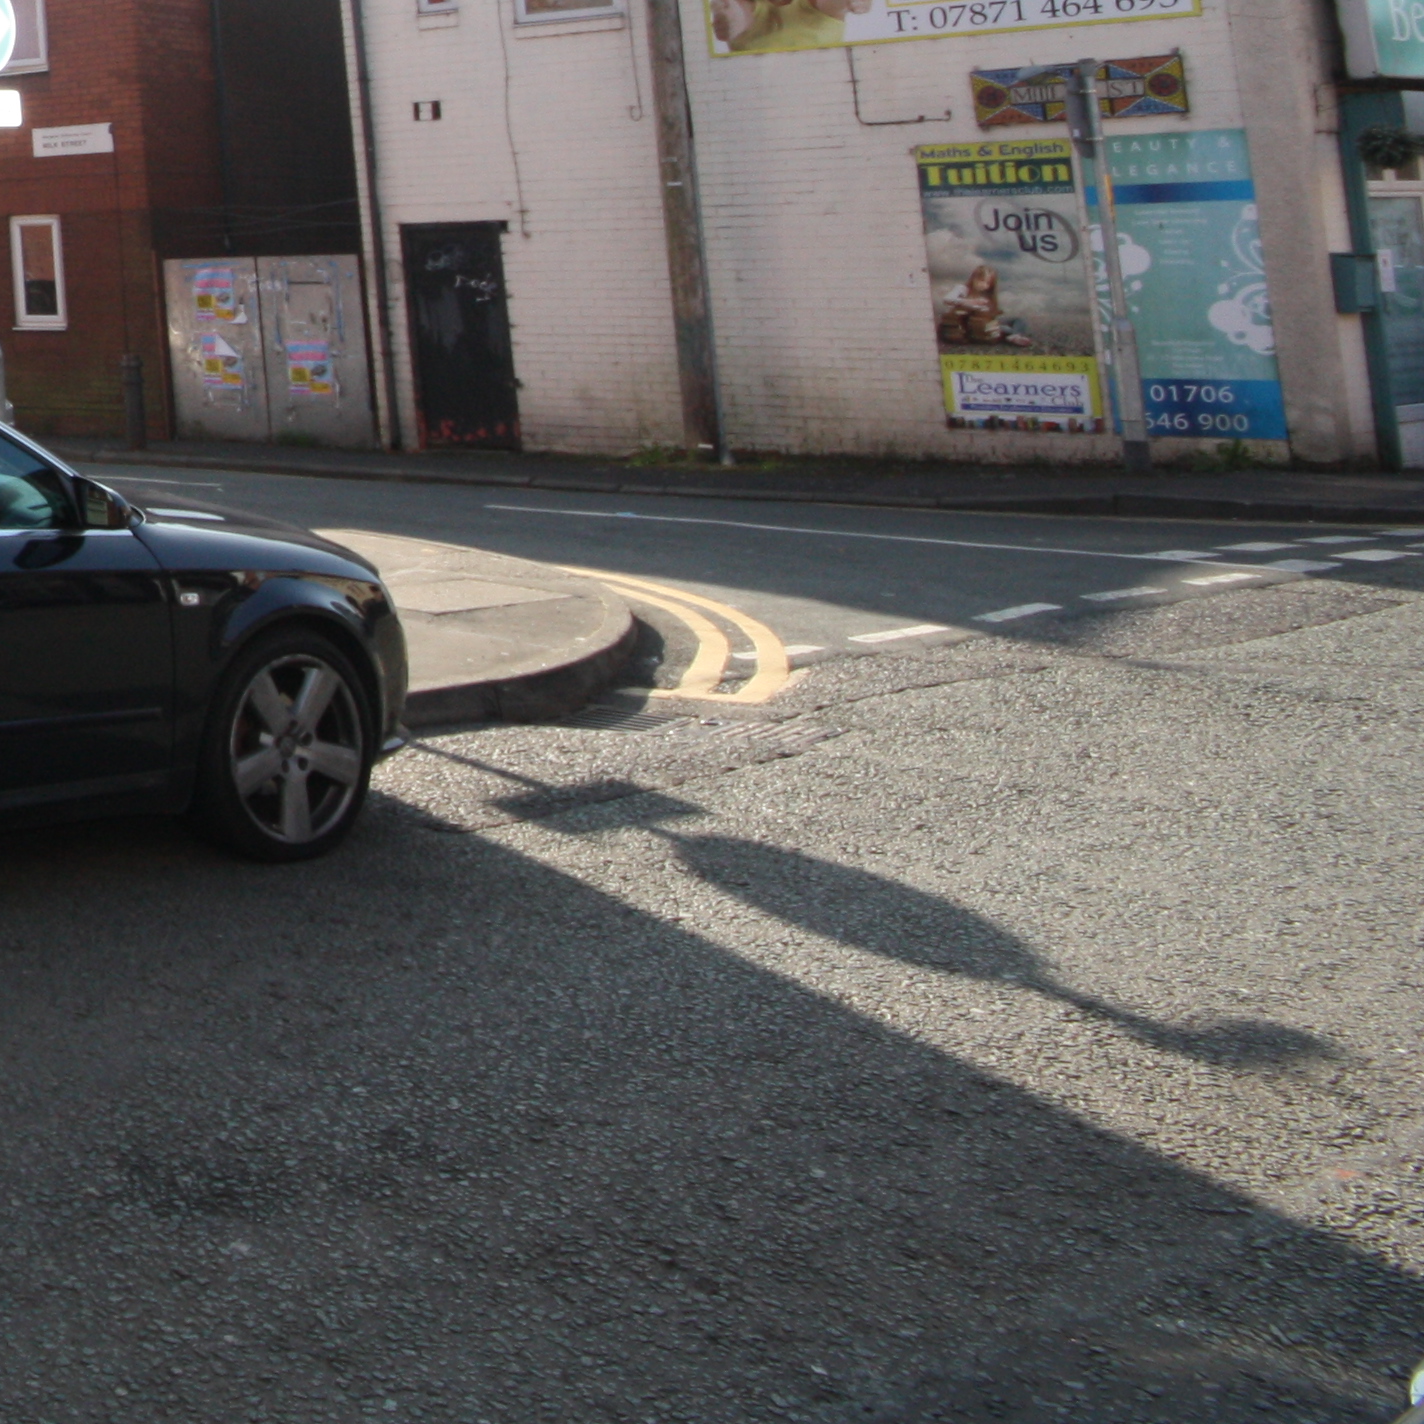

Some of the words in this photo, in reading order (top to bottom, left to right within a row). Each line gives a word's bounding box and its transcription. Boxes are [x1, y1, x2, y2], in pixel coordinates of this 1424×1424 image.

[887, 9, 918, 33] T:
[929, 0, 1027, 30] 07871
[920, 146, 971, 158] Maths
[978, 146, 992, 157] &
[999, 143, 1064, 157] English
[1112, 138, 1197, 154] EAUTY
[1217, 136, 1231, 149] &
[921, 161, 1070, 186] Tuition
[1112, 160, 1238, 178] LEGANCE
[983, 208, 1053, 232] Join
[1018, 234, 1059, 253] us
[1150, 384, 1234, 404] 01706
[1197, 413, 1249, 432] 900
